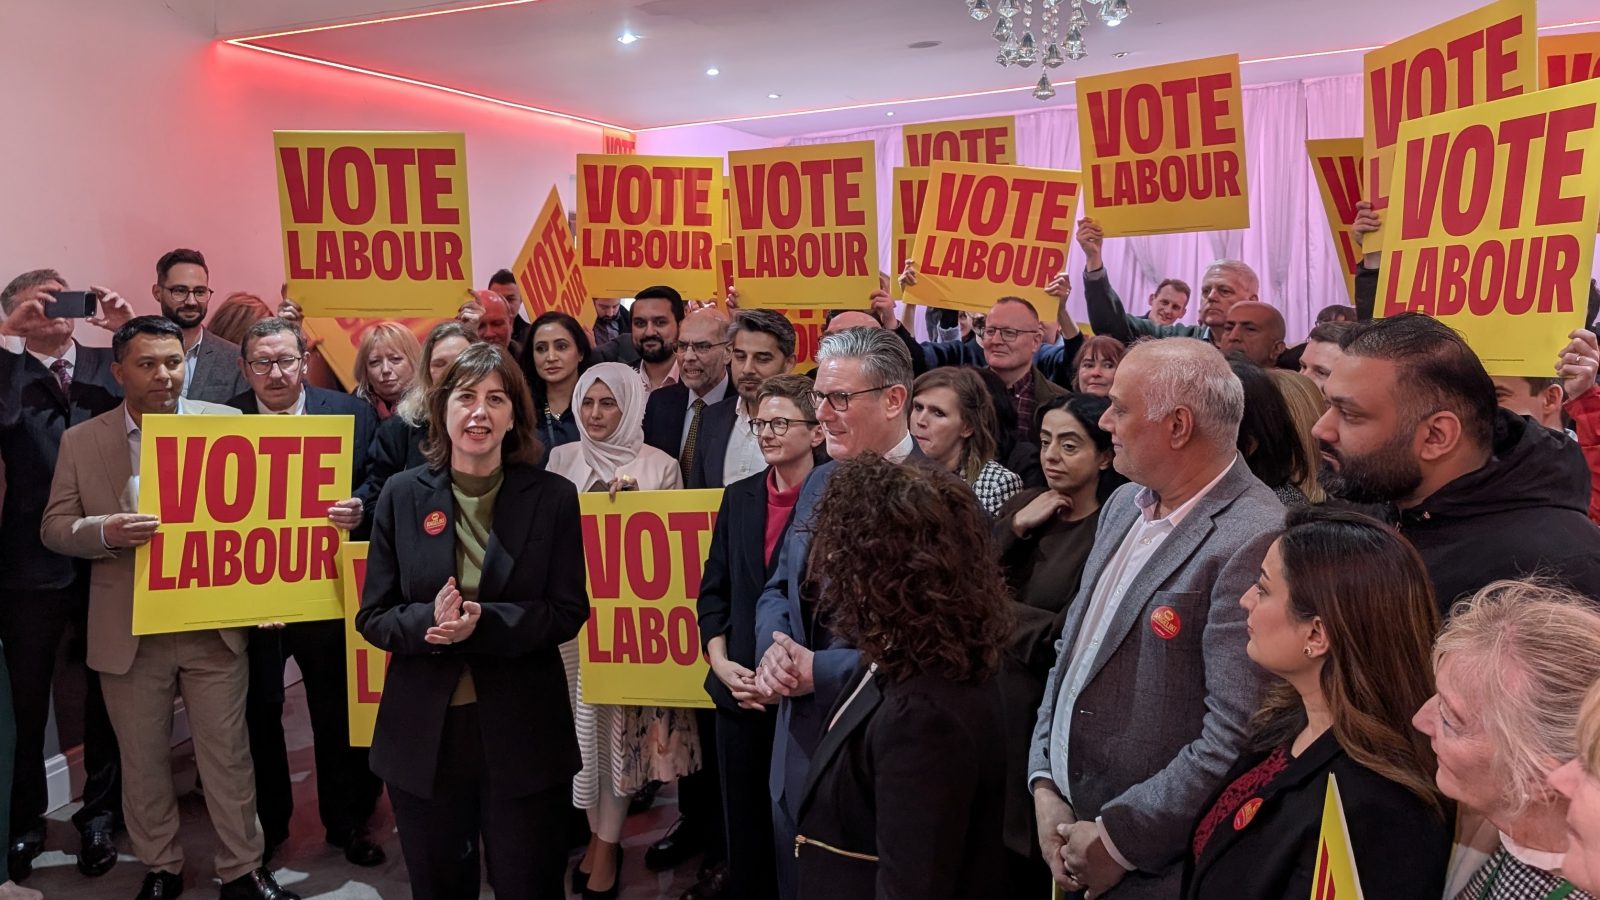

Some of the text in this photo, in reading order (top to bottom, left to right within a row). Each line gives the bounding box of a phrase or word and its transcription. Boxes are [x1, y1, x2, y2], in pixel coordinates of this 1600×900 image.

[1086, 72, 1237, 158] VOTE
[1370, 15, 1524, 149] VOTE
[906, 126, 1009, 167] VOTE
[1091, 150, 1243, 209] LABOUR
[1401, 102, 1597, 241] VOTE
[279, 145, 461, 226] VOTE
[583, 164, 713, 227] VOTE
[733, 157, 866, 231] VOTE
[936, 172, 1078, 244] VOTE
[286, 229, 465, 282] LABOUR
[520, 203, 575, 317] VOTE
[582, 228, 713, 270] LABOUR
[736, 231, 869, 280] LABOUR
[920, 234, 1066, 289] LABOUR
[1384, 234, 1581, 318] LABOUR
[556, 264, 588, 316] OUR
[155, 434, 343, 524] VOTE
[148, 525, 340, 591] LABOUR
[581, 511, 718, 600] VOT
[585, 605, 711, 666] LABO
